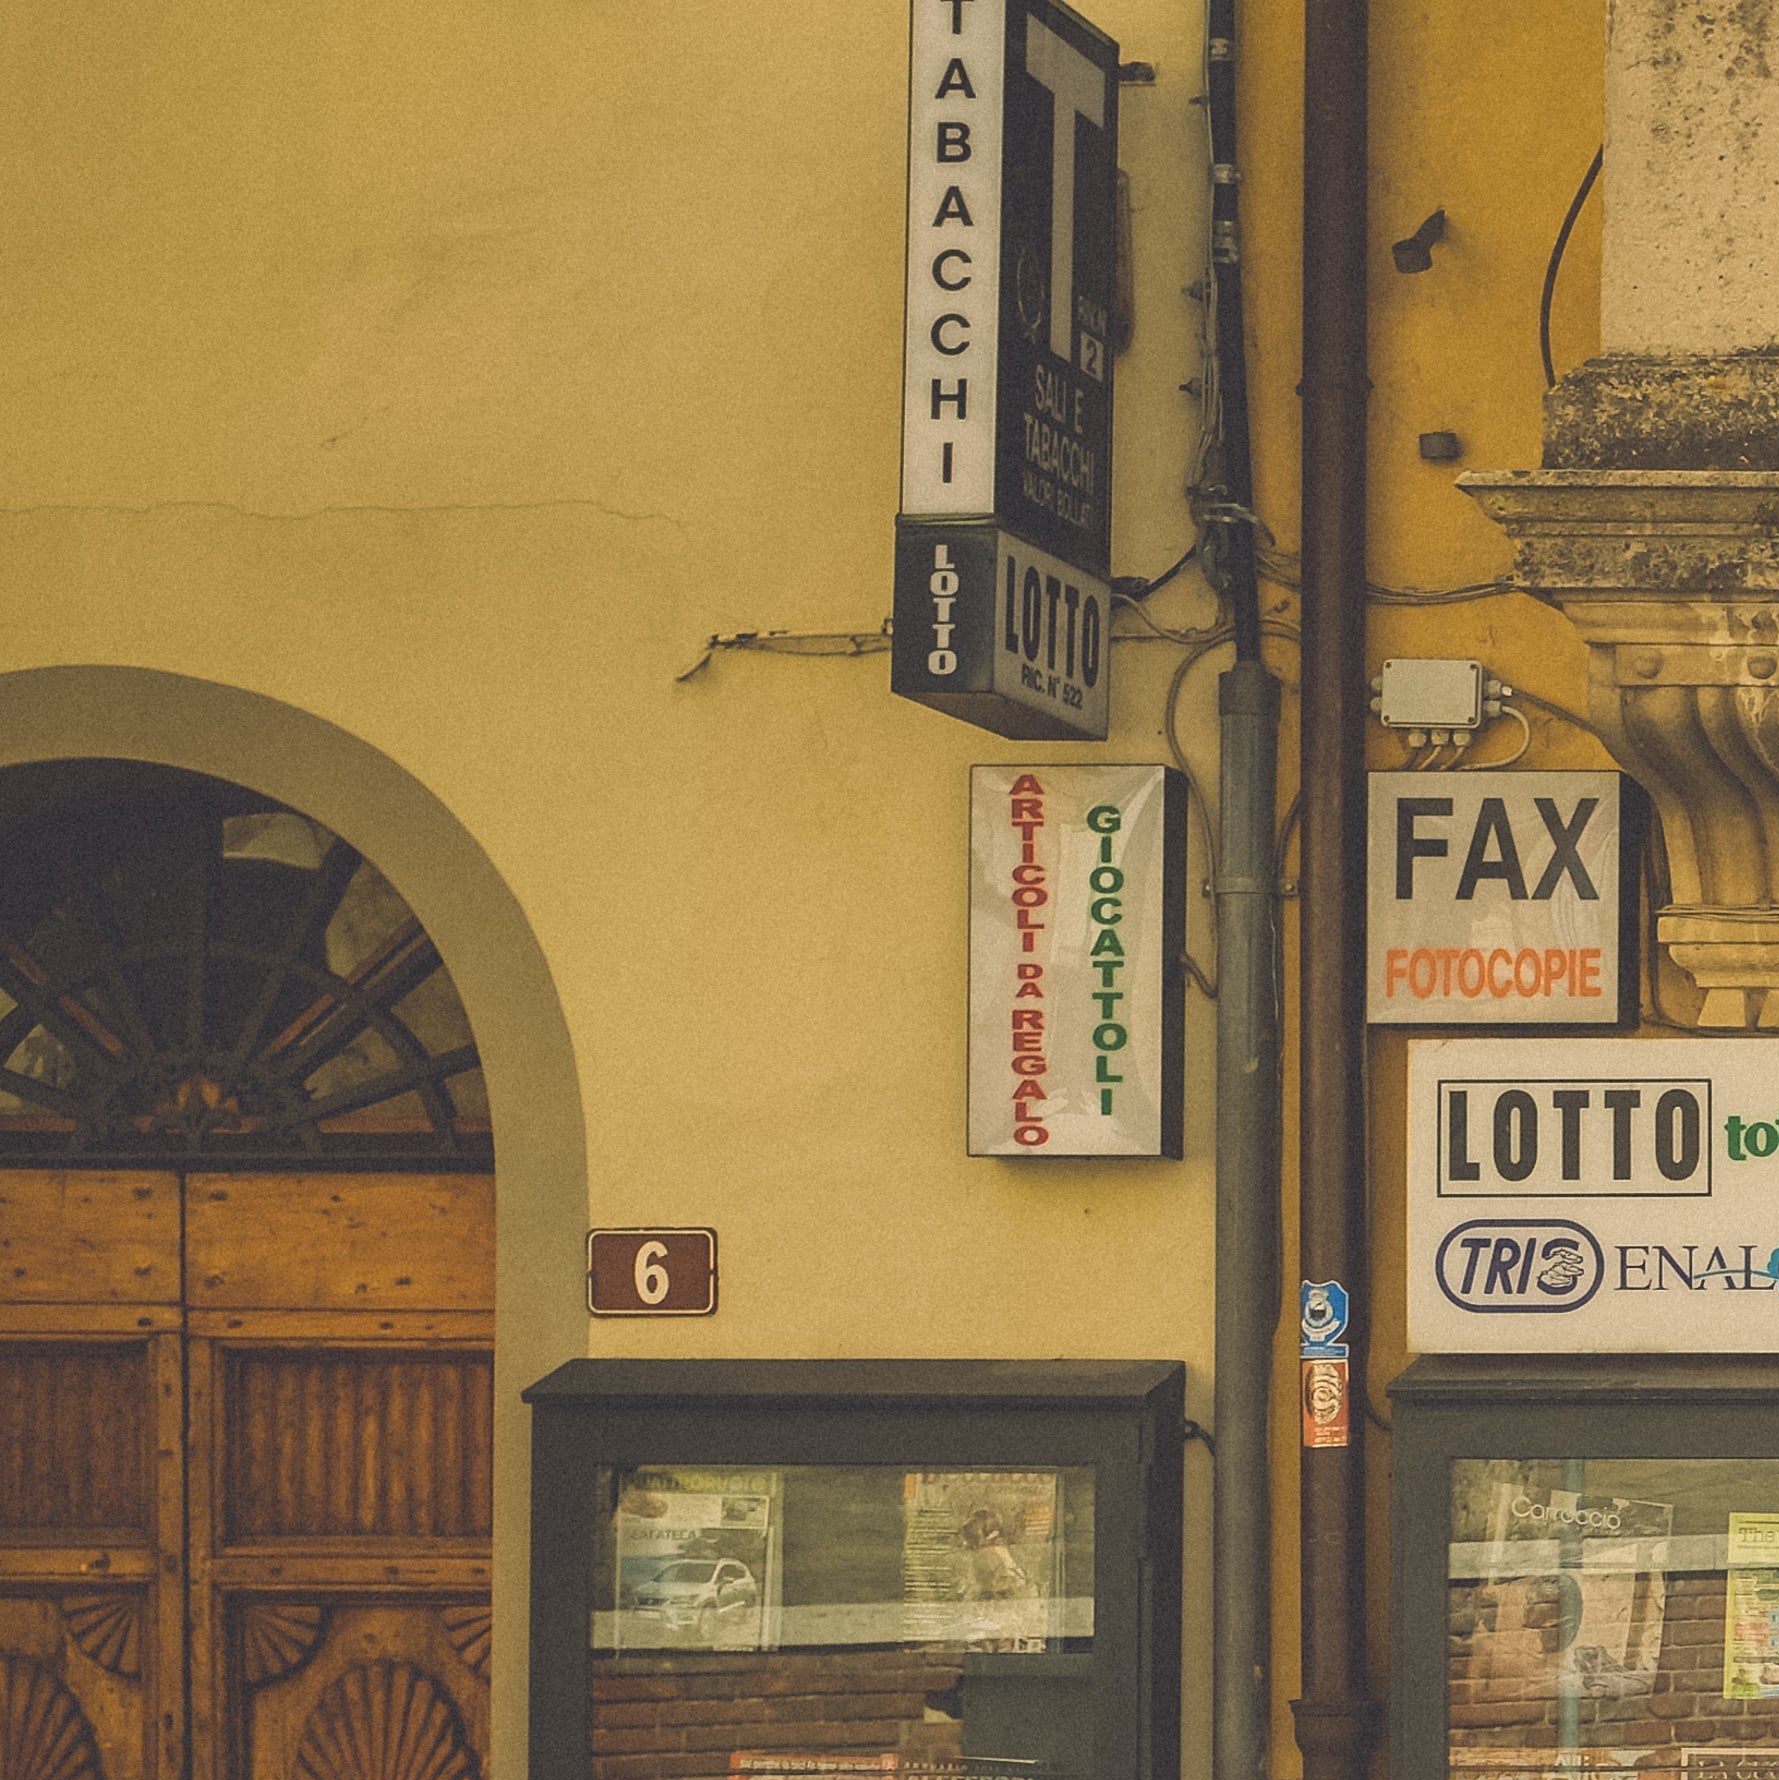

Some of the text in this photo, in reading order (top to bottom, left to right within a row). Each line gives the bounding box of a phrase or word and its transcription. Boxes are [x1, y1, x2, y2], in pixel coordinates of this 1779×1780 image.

[930, 0, 976, 484] TABACCHI
[1035, 364, 1067, 424] SALI
[1024, 412, 1095, 496] TABACCHI
[929, 545, 957, 676] LOTTO
[1005, 555, 1100, 689] LOTTO
[1021, 663, 1083, 710] RIC. 522
[1395, 797, 1601, 902] FAX
[1009, 774, 1050, 1146] ARTICOLI DA REGALO
[1086, 805, 1128, 1115] GIOCATTOLI
[1384, 947, 1602, 998] FOTOCOPIE
[1448, 1089, 1702, 1182] LOTTO
[634, 1241, 670, 1305] 6
[1459, 1238, 1584, 1296] TRIS
[1738, 1526, 1775, 1545] The
